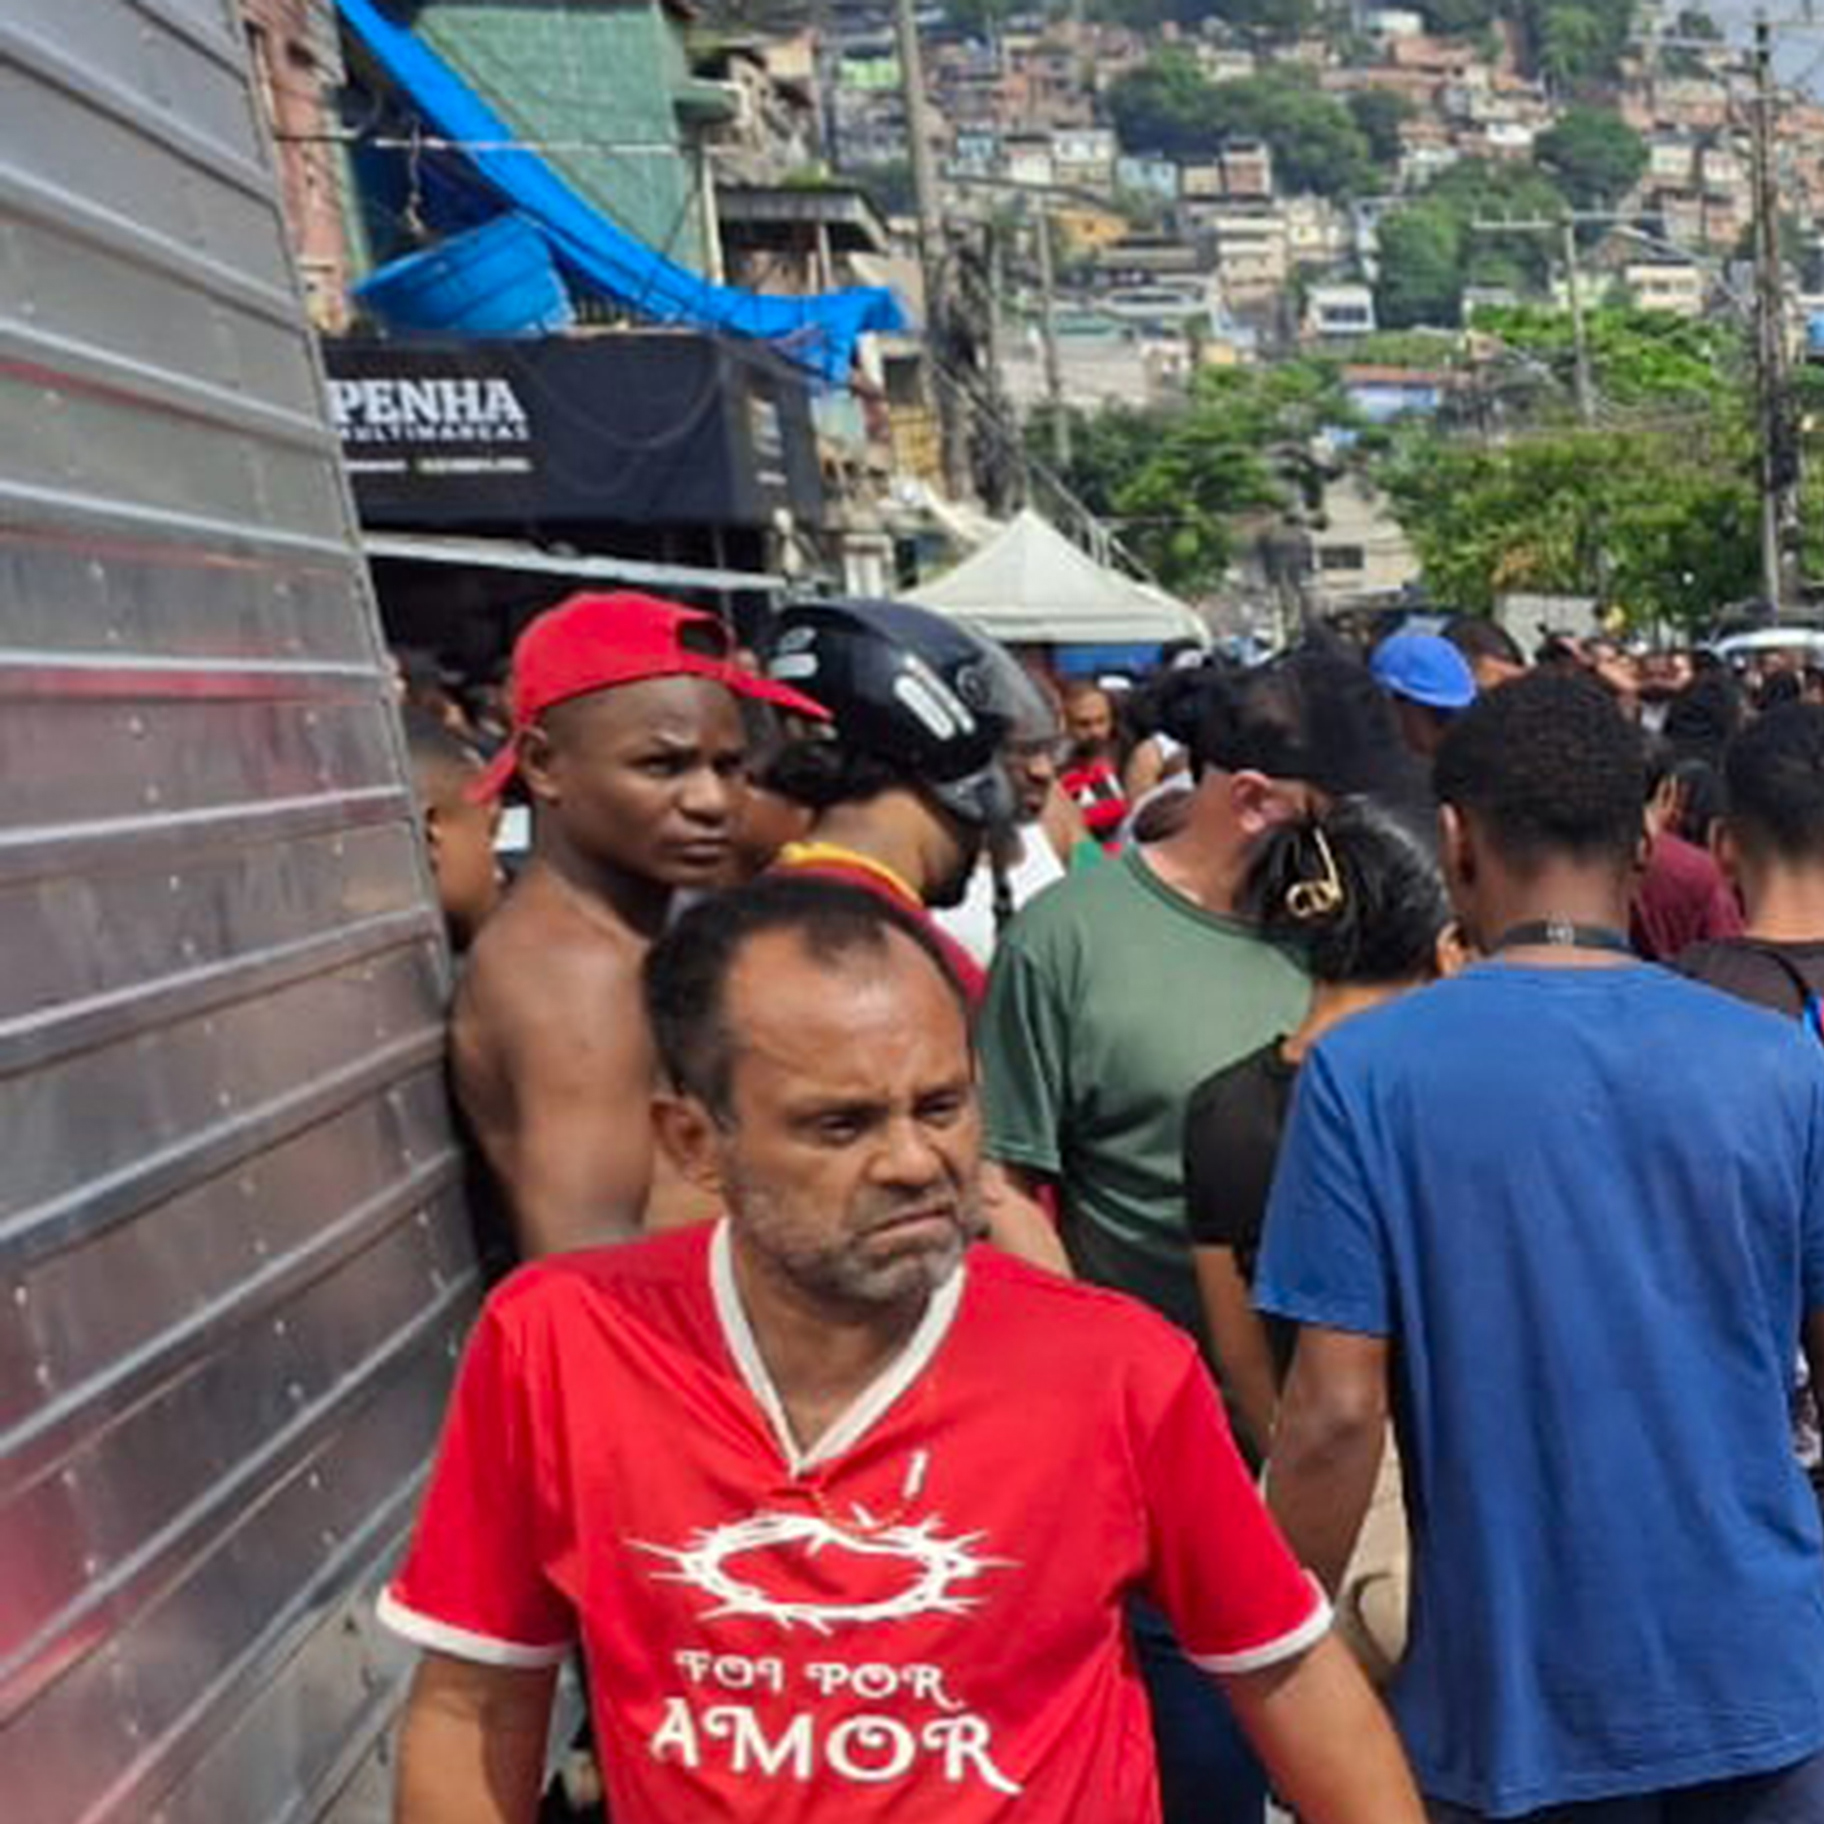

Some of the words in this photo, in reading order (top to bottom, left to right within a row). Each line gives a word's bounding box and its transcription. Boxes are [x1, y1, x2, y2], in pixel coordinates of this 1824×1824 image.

[327, 378, 528, 424] PENHA
[675, 1650, 784, 1693] FOI
[805, 1662, 966, 1711] POR
[650, 1697, 1024, 1797] AMOR
